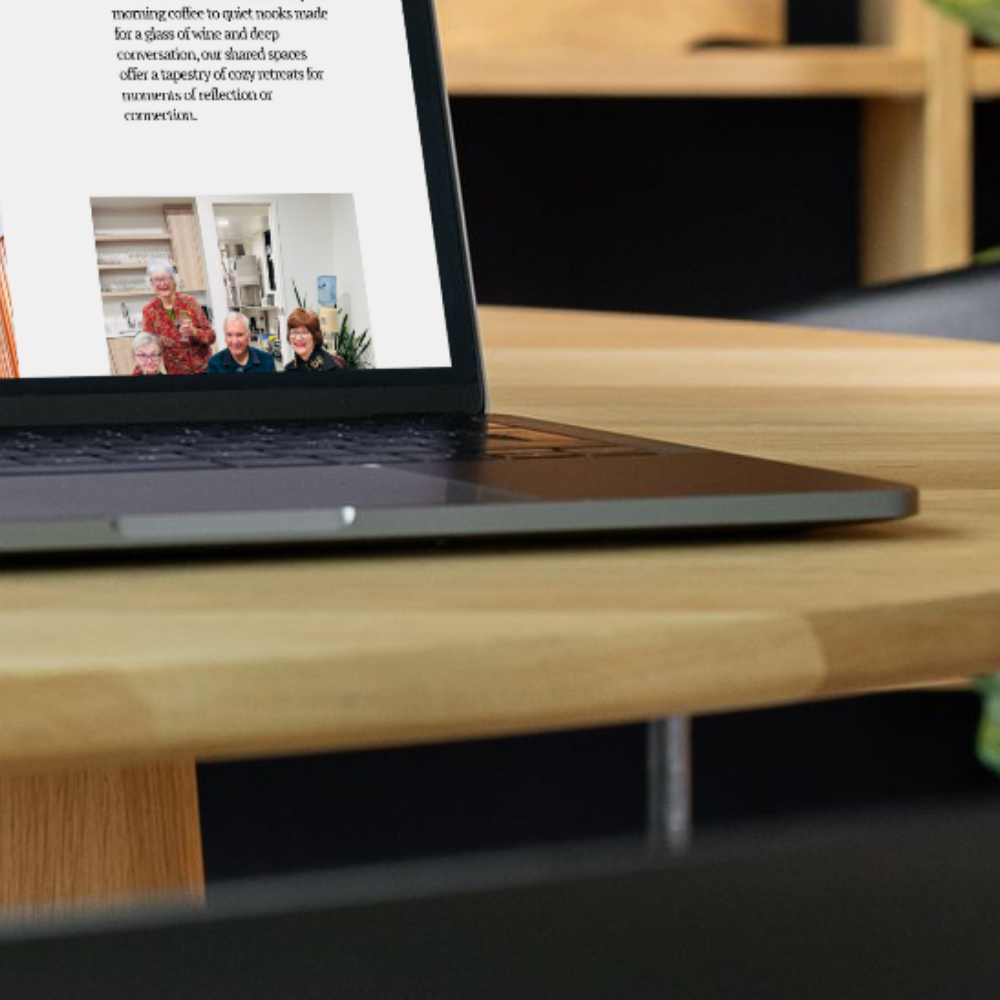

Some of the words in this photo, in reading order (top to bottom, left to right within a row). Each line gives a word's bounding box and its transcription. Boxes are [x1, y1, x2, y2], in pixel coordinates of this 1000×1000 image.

[112, 7, 166, 22] morning
[168, 7, 204, 19] coffee
[206, 9, 220, 19] to
[223, 7, 252, 22] quiet
[256, 7, 293, 19] nooks
[295, 7, 328, 19] made
[115, 27, 132, 40] for
[135, 30, 142, 40] a
[144, 27, 174, 42] glass
[177, 27, 190, 40] of
[192, 27, 222, 40] wine
[225, 27, 247, 40] and
[250, 27, 280, 42] deep
[117, 48, 200, 62] conversation,
[201, 51, 221, 60] our
[225, 47, 266, 60] shared
[268, 51, 307, 61] spaces
[119, 67, 148, 80] offer
[151, 71, 158, 80] a
[161, 69, 211, 83] tapestry
[213, 67, 227, 80] of
[228, 71, 256, 82] cozy
[258, 69, 304, 80] retreats
[307, 67, 324, 80] for
[122, 91, 181, 101] moments
[184, 87, 196, 100] of
[199, 87, 257, 101] reflection
[259, 91, 272, 101] or
